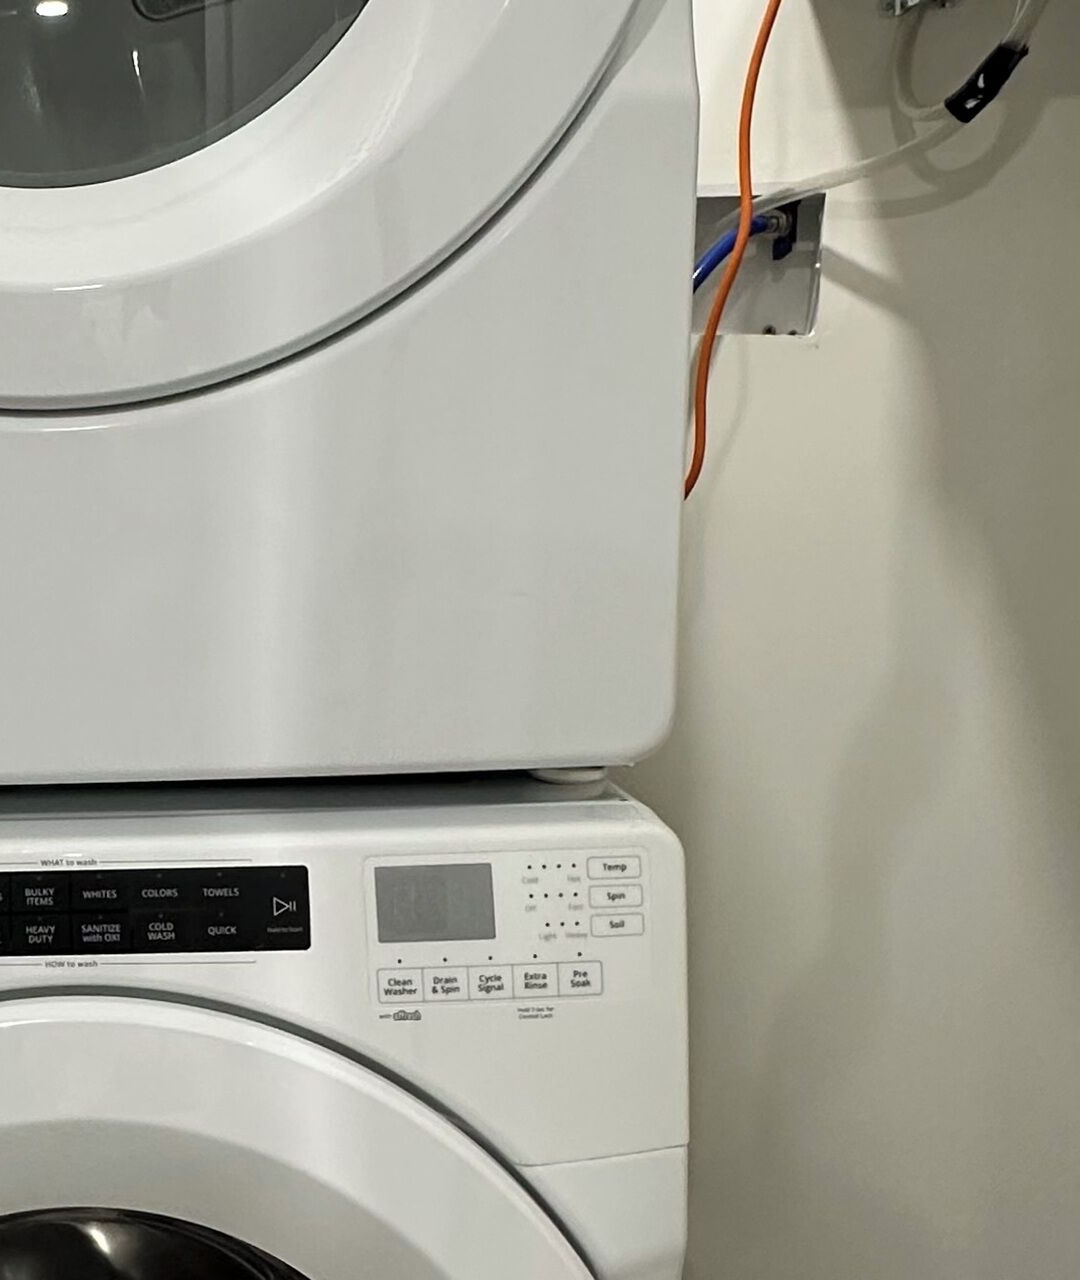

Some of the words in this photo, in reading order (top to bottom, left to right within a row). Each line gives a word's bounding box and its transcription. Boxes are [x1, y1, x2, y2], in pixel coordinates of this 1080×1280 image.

[40, 858, 64, 866] WHAT
[76, 858, 98, 866] wash
[603, 863, 627, 872] Temp
[24, 888, 54, 898] BULKY
[83, 889, 117, 899] WHITES
[141, 888, 178, 898] COLORS
[202, 887, 239, 897] TOWELS
[607, 892, 626, 902] Spin
[26, 897, 54, 906] ITEMS
[81, 924, 120, 933] SANITIZE
[148, 922, 174, 931] COLD
[609, 920, 625, 929] Soil
[25, 925, 55, 935] HEAVY
[208, 925, 237, 936] QUICK
[28, 934, 53, 944] DUTY
[82, 933, 103, 942] with
[148, 931, 175, 941] WASH
[45, 960, 65, 968] HOW
[77, 959, 98, 967] wash
[524, 971, 547, 981] Extra
[573, 969, 588, 978] Pre
[388, 977, 413, 987] Clean
[433, 975, 458, 985] Drain
[478, 974, 502, 984] Cycle
[570, 978, 591, 988] Soak
[432, 985, 439, 994] &
[441, 984, 461, 995] Spin
[478, 982, 505, 994] Signal
[524, 980, 548, 990] Rinse
[383, 986, 417, 996] Washer
